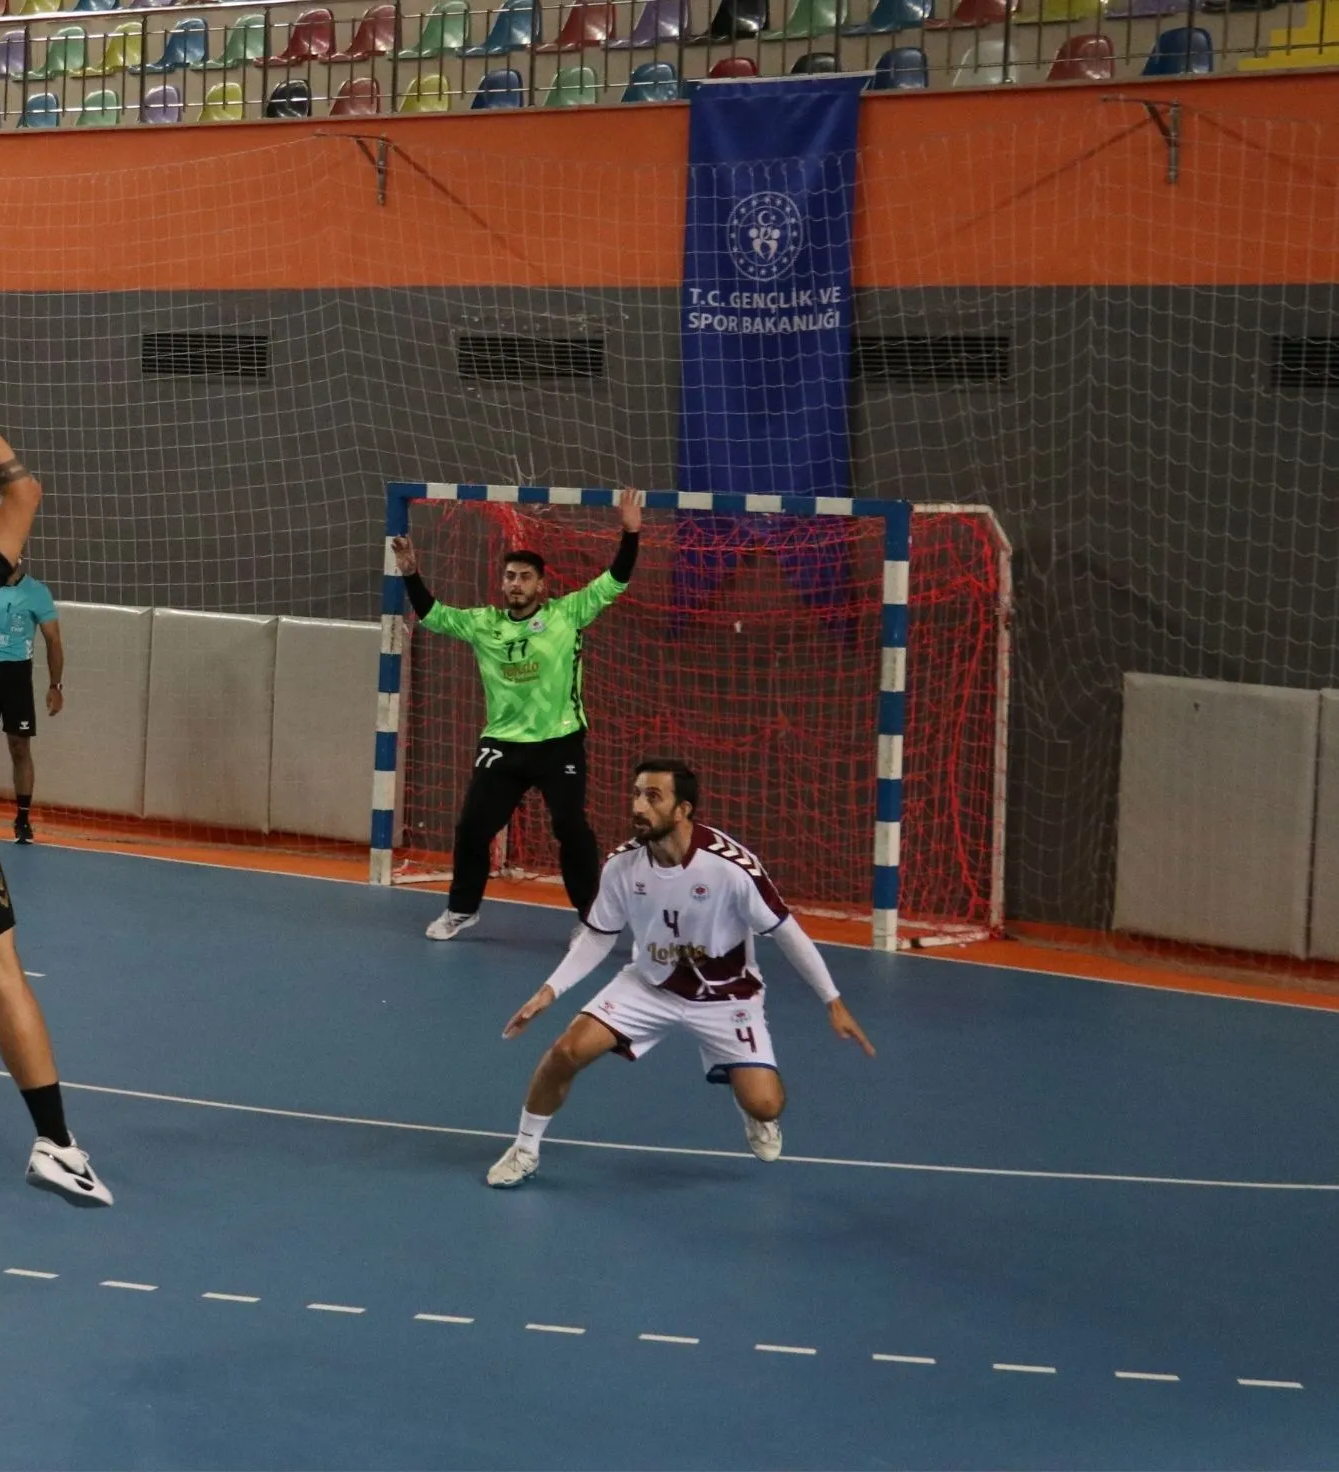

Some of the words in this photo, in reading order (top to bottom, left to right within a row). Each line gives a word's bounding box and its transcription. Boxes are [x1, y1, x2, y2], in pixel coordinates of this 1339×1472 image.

[689, 288, 726, 307] T.C.
[730, 287, 812, 313] GENÇLİK
[820, 286, 841, 305] VE
[688, 312, 738, 332] SPOR
[742, 309, 841, 335] BAKANLIĞI
[504, 638, 530, 662] 77
[475, 747, 504, 769] 77
[663, 909, 680, 938] 4
[735, 1026, 757, 1053] 4
